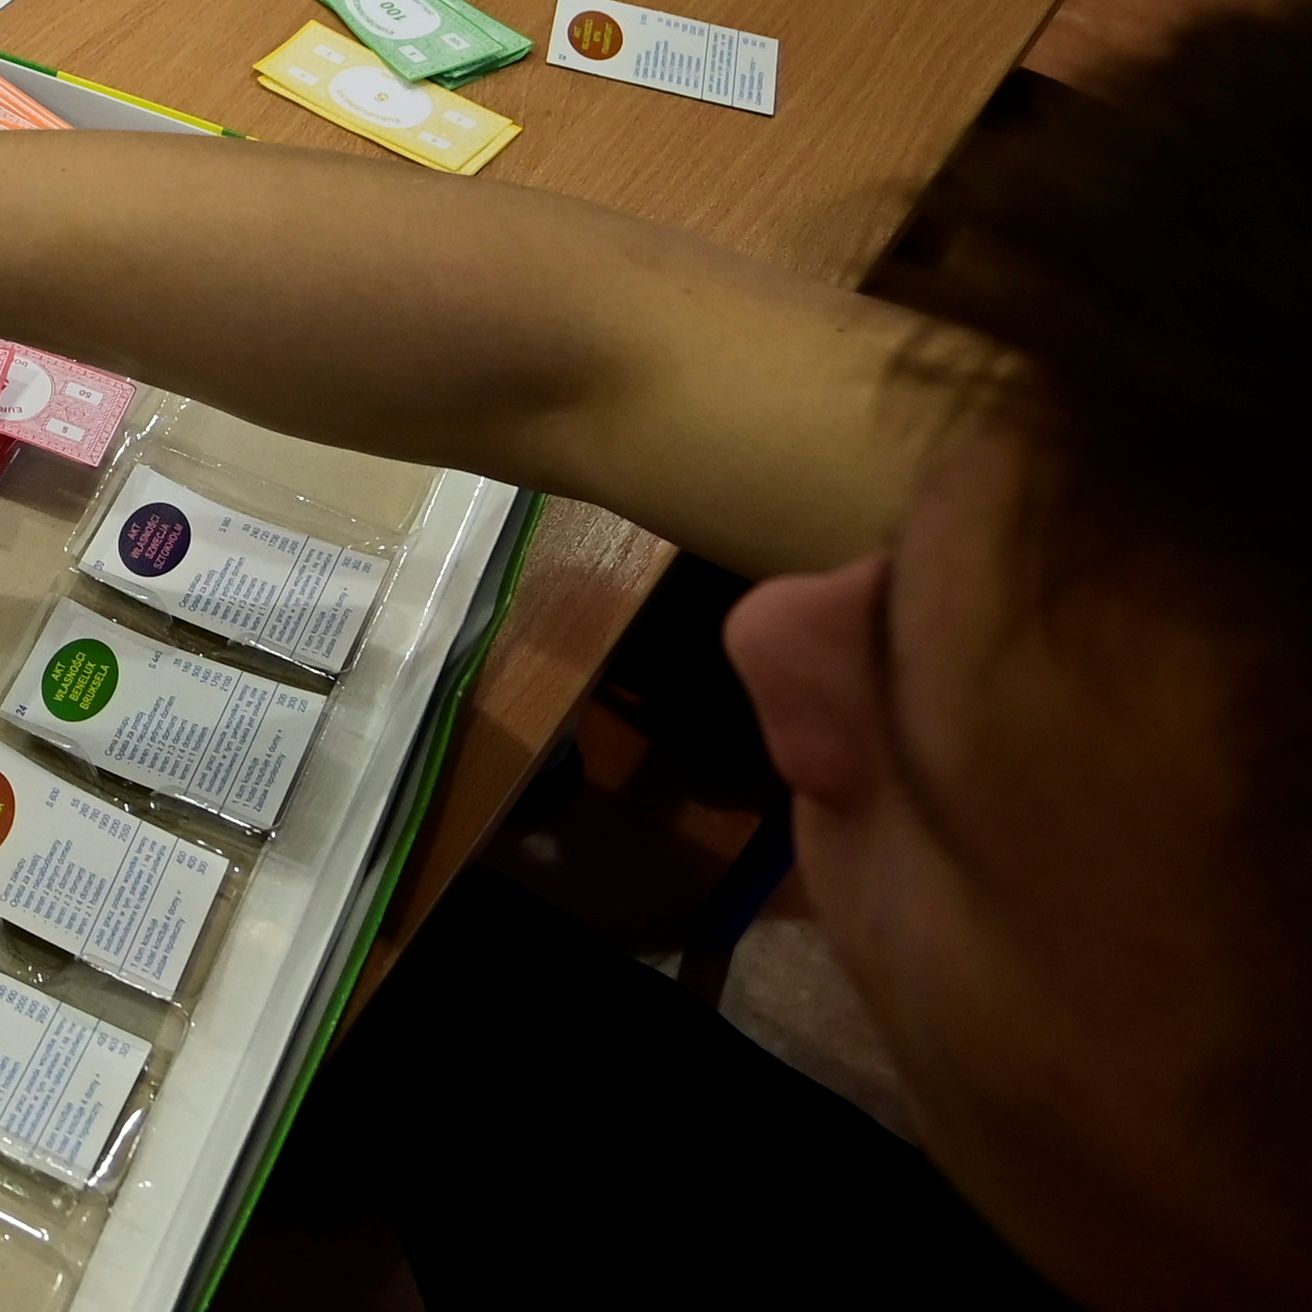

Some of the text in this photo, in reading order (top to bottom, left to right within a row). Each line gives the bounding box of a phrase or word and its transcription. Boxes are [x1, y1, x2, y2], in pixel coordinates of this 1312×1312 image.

[380, 0, 408, 22] 100
[78, 389, 93, 400] 50
[127, 522, 140, 540] AKT
[130, 514, 160, 559] WŁASNOŚCI
[144, 524, 170, 559] SZWECJA
[153, 523, 183, 570] SZTOKHOLM
[51, 661, 66, 681] AKT
[53, 652, 86, 702] WŁASNOŚCI
[68, 661, 96, 702] BENELUX
[79, 665, 110, 710] BRUKSELA
[16, 704, 27, 716] 24
